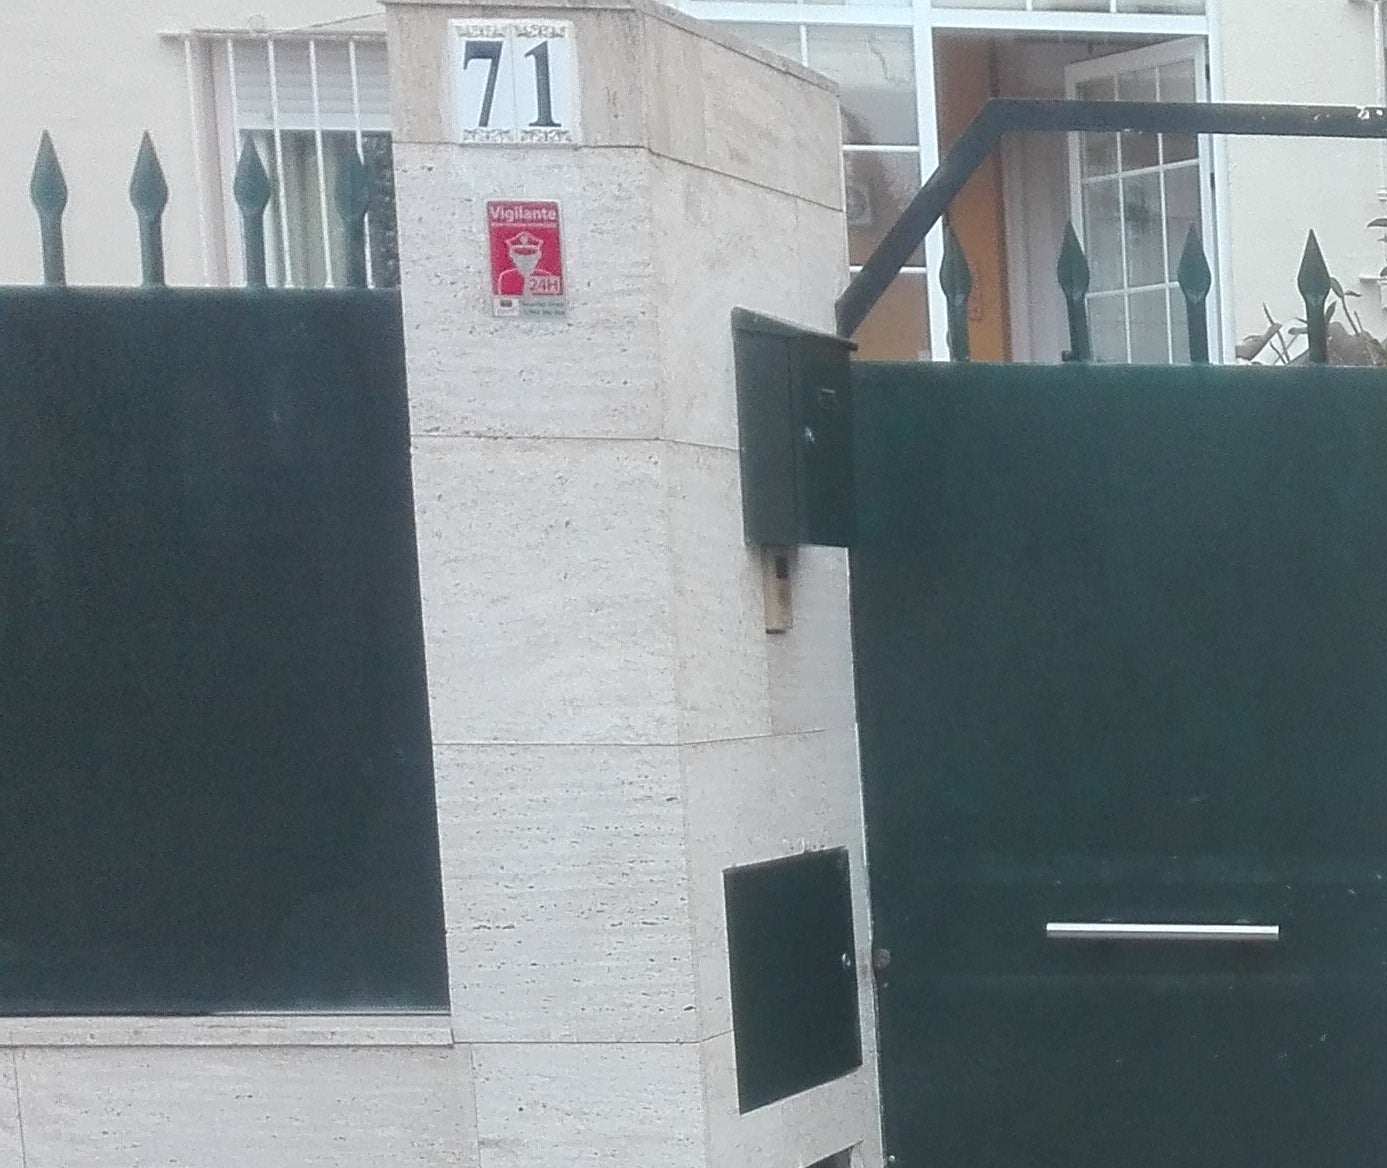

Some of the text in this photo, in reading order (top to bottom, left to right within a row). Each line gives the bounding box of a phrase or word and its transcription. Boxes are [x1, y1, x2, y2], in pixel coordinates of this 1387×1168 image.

[463, 40, 562, 127] 71
[489, 205, 556, 222] Vigilante
[530, 278, 558, 291] 24H
